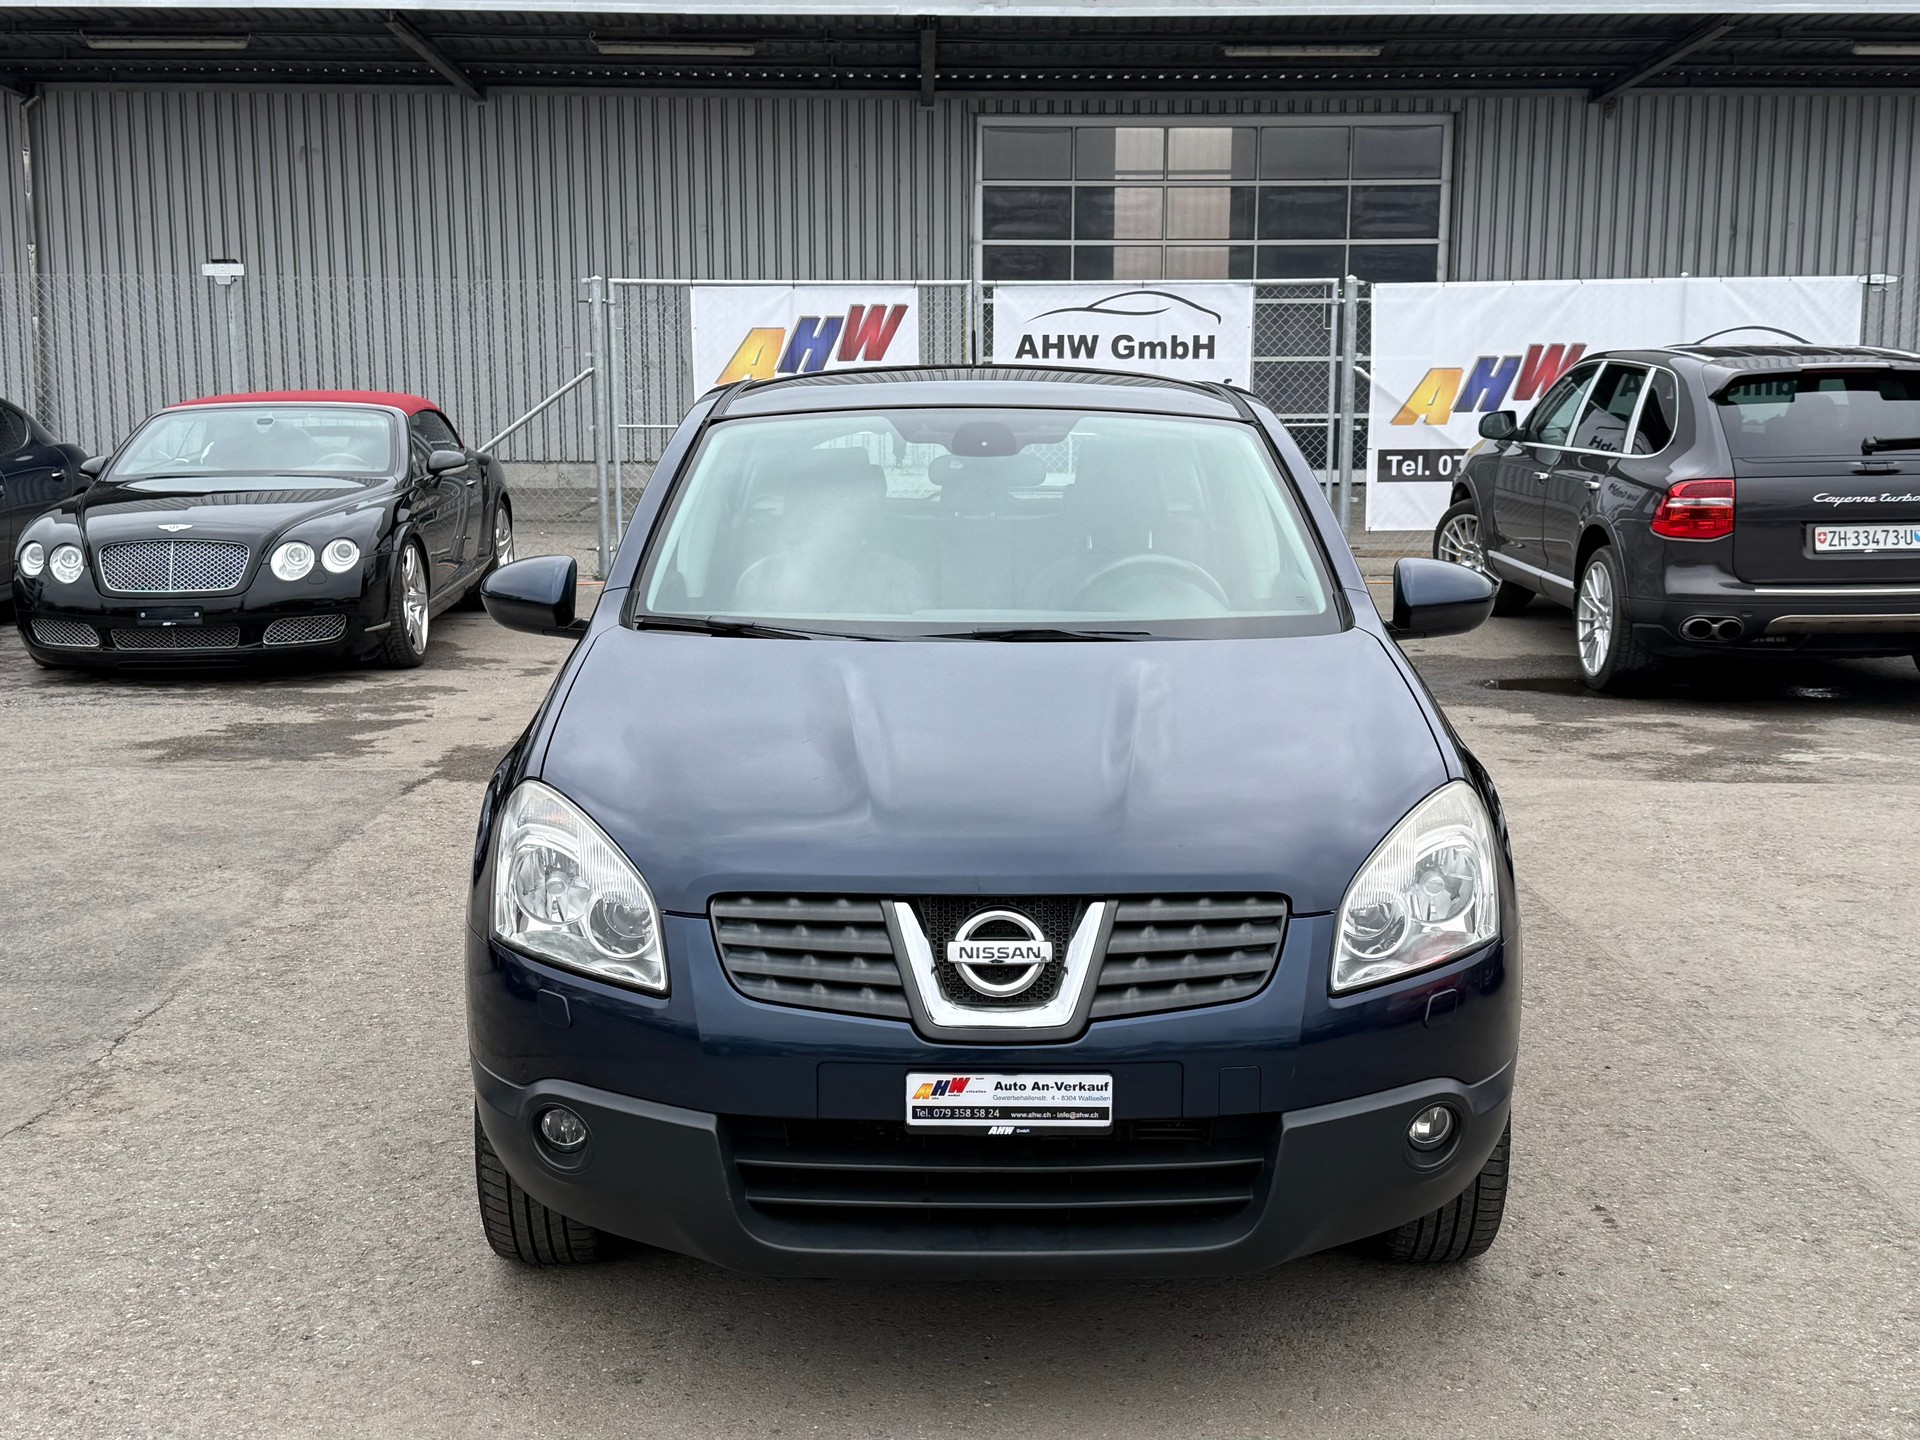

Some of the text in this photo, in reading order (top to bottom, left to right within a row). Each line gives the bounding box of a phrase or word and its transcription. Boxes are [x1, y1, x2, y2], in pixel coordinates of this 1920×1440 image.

[715, 303, 909, 384] AHW
[1015, 334, 1216, 360] AHW GmbH
[1390, 343, 1587, 426] AHW
[1386, 455, 1431, 476] Tel.
[1813, 492, 1920, 508] Cayenne turbo
[959, 946, 1041, 959] NISSAN
[912, 1077, 971, 1100] AHW
[994, 1081, 1110, 1092] Auto An-Verkauf
[916, 1108, 1000, 1118] Tel. 079 358 58 24
[1056, 1111, 1099, 1119] info@ahw.ch
[988, 1126, 1015, 1135] AHW
